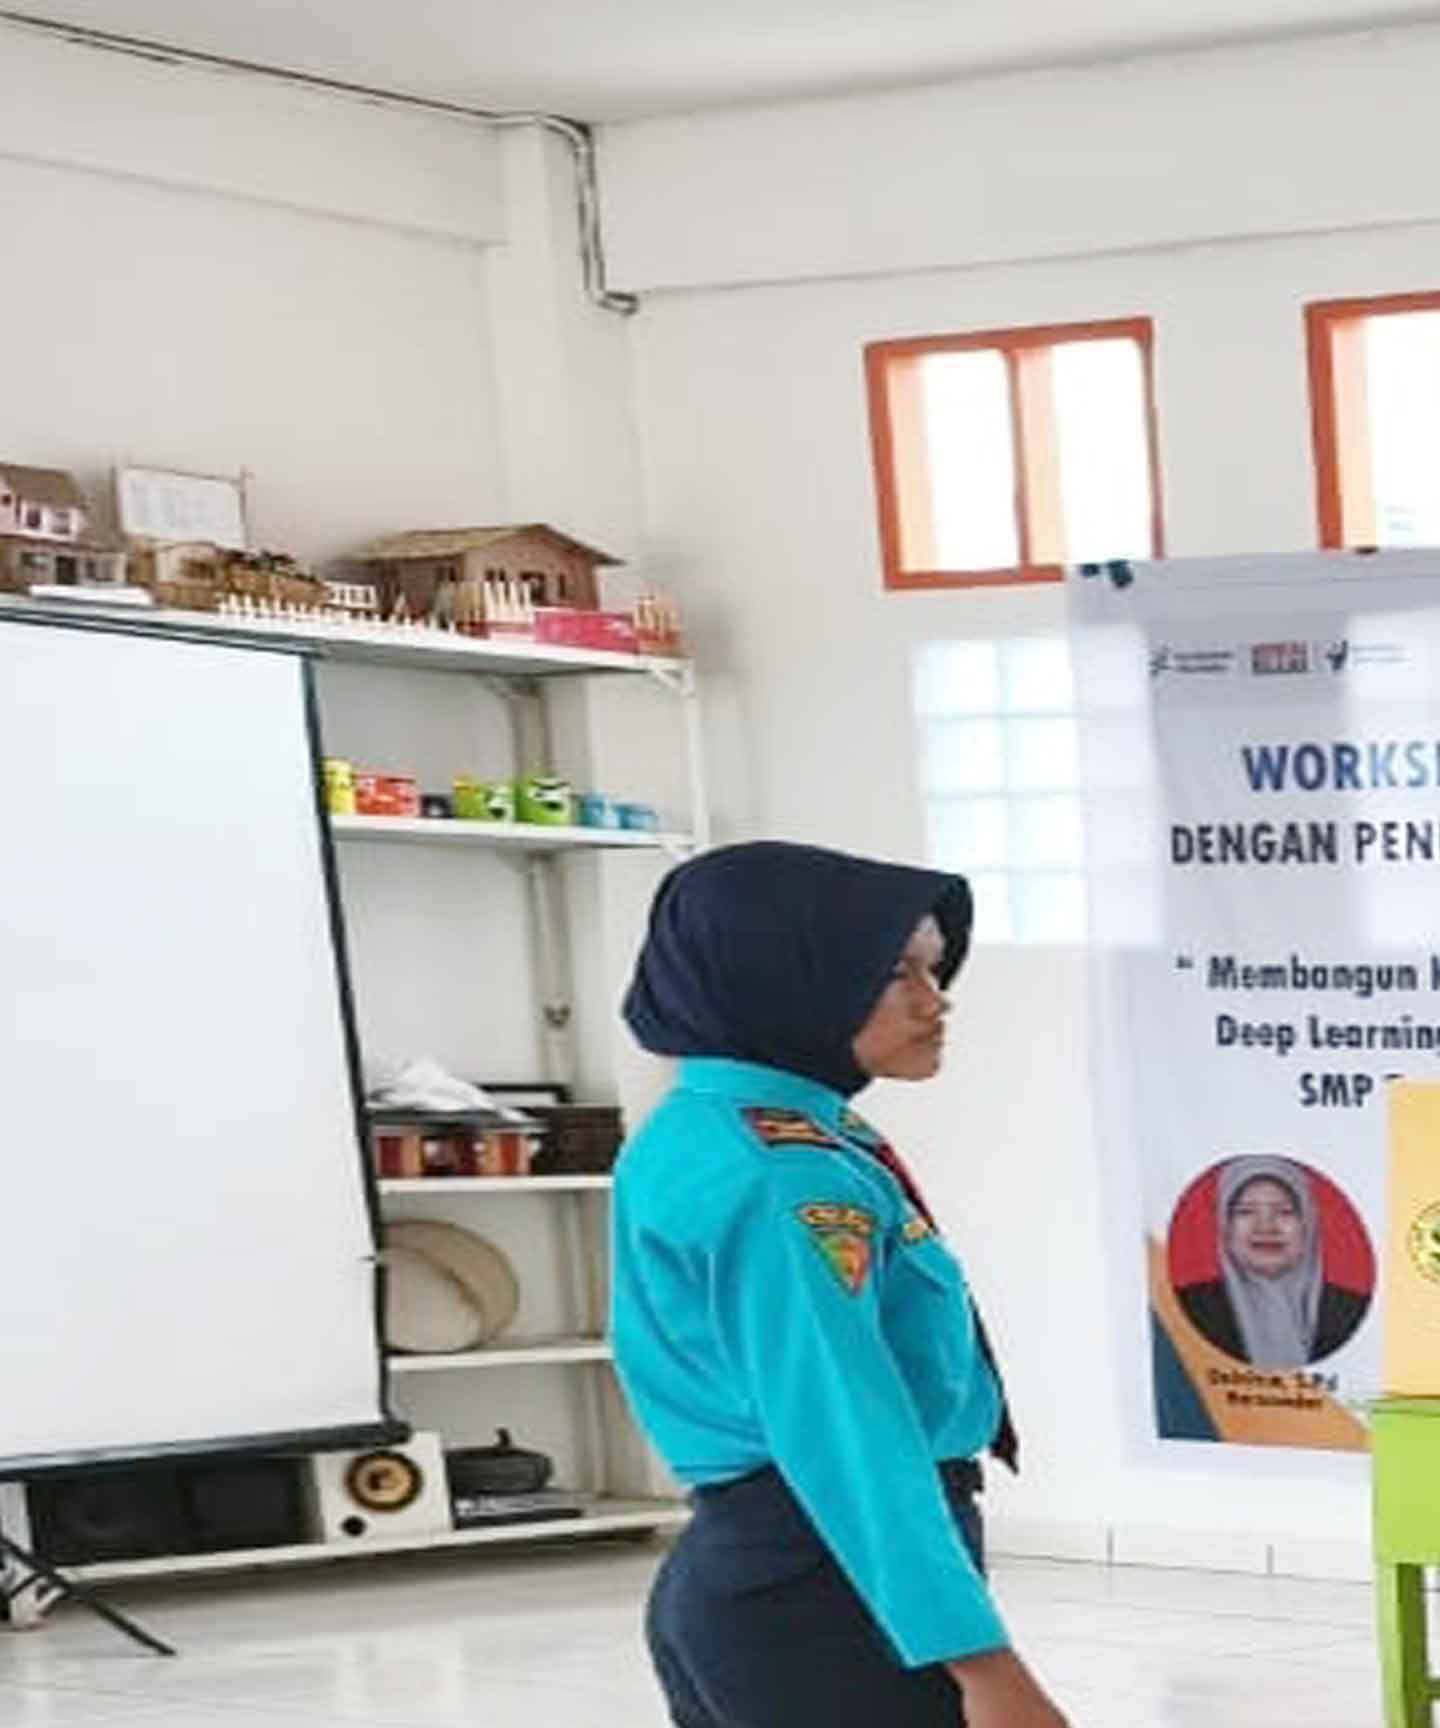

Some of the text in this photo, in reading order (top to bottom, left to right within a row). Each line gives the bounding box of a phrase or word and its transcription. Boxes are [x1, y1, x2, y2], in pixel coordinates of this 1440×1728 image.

[1171, 821, 1338, 865] DENGAN
[1208, 955, 1417, 997] Membangun
[1216, 1014, 1295, 1056] Deep
[1299, 1073, 1374, 1108] SMP
